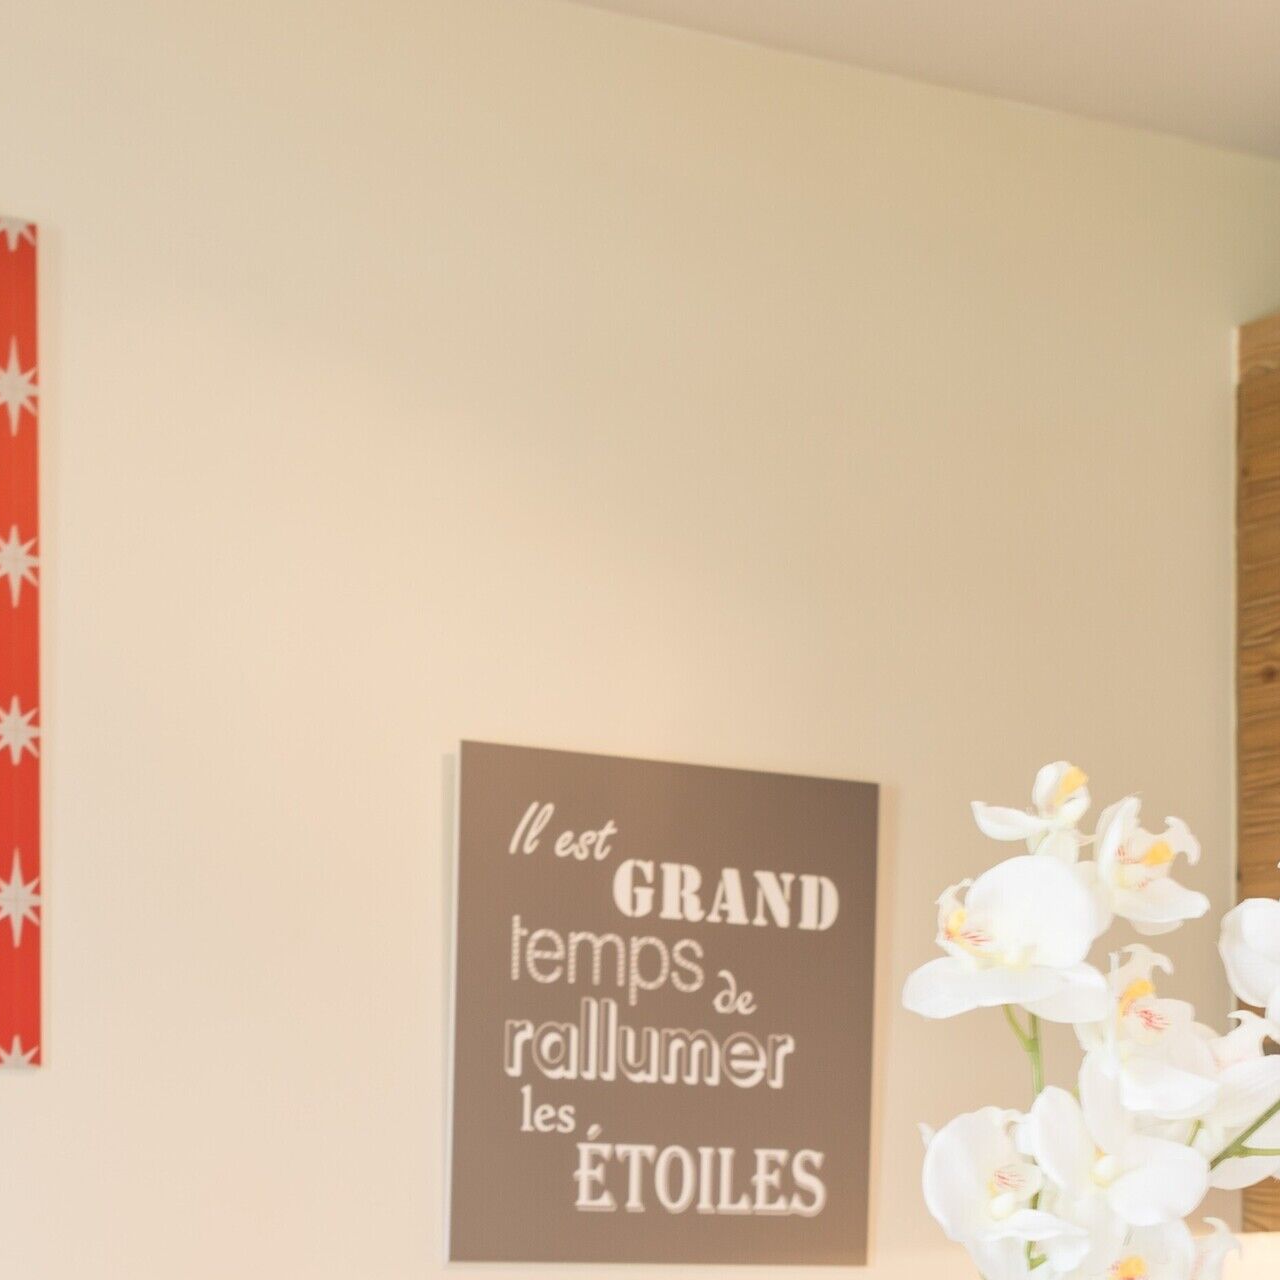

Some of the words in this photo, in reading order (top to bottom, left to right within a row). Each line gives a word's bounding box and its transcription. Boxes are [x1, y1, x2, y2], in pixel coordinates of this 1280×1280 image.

[509, 801, 554, 854] Il
[554, 820, 616, 860] est
[613, 858, 839, 931] GRAND
[510, 914, 704, 1006] temps
[713, 969, 757, 1015] de
[504, 997, 795, 1089] rallumer
[521, 1085, 576, 1133] les
[574, 1124, 827, 1217] ÉTOILES
